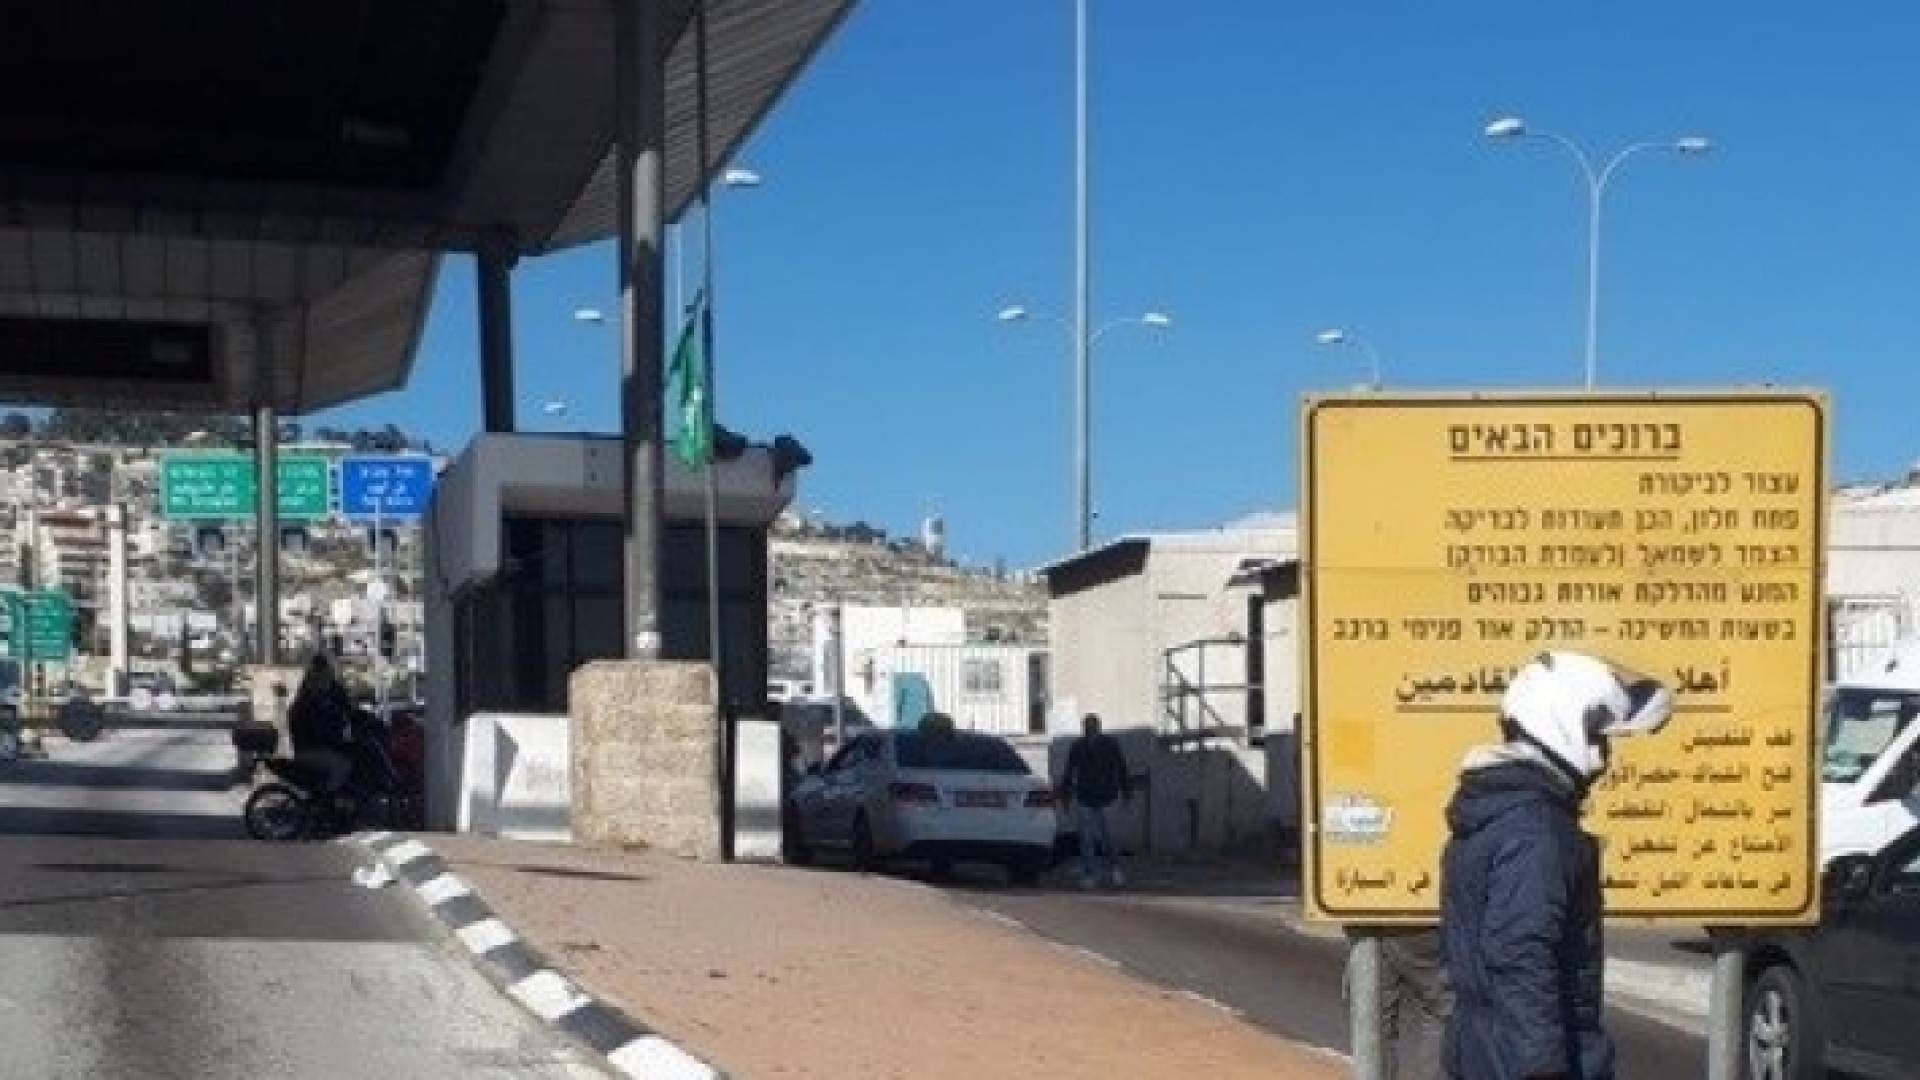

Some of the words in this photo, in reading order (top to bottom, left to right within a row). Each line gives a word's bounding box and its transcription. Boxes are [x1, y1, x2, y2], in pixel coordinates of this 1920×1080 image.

[1448, 423, 1554, 453] הבאים
[1573, 423, 1681, 451] ברוכים
[1743, 472, 1800, 495] עצור
[1541, 509, 1623, 530] תעודות
[1635, 509, 1673, 534] הכן
[1752, 509, 1800, 530] פתח
[1636, 542, 1721, 566] לשמאל
[1557, 583, 1623, 602] אורות
[1476, 619, 1514, 640] אור
[1719, 620, 1796, 640] בשעות
